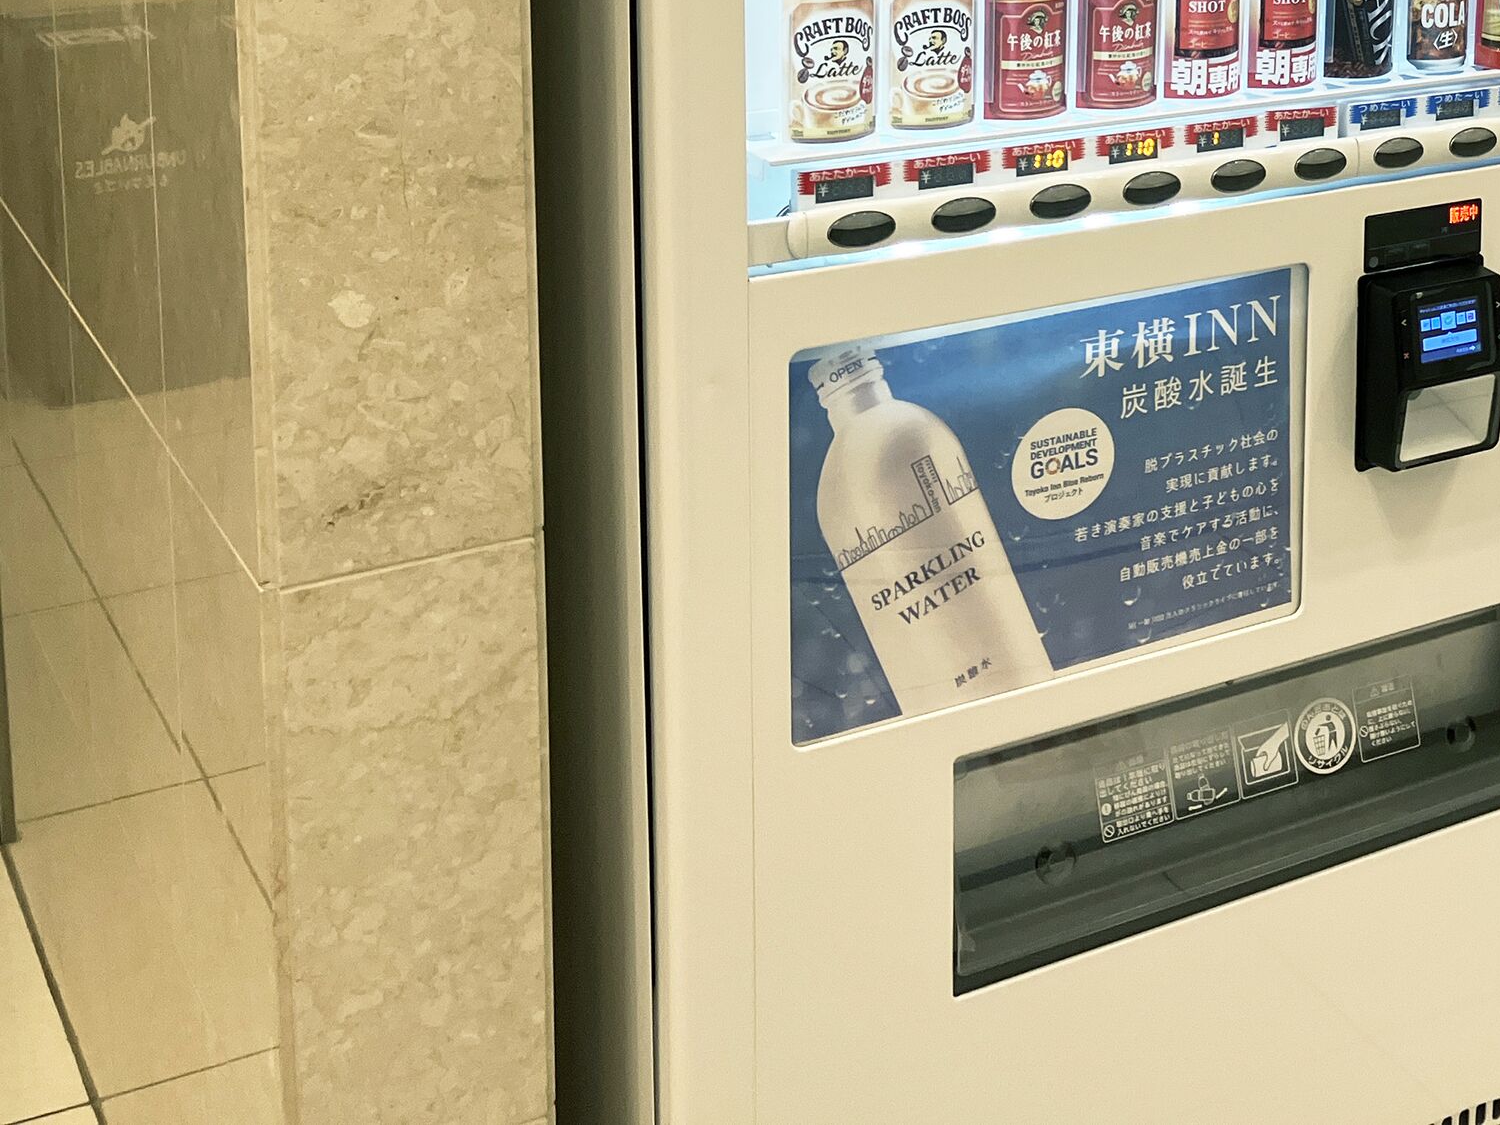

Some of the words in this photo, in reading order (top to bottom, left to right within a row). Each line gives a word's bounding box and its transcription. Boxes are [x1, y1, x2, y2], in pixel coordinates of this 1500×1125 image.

[1188, 0, 1226, 14] SHOT
[1421, 1, 1465, 29] COLA
[794, 17, 845, 57] CRAFT
[845, 16, 873, 52] BOSS
[894, 8, 942, 46] CRAFT
[943, 7, 972, 42] BOSS
[1006, 30, 1062, 52] 午後の紅茶
[1099, 21, 1153, 43] 午後の紅茶
[810, 61, 863, 79] Latte
[910, 51, 961, 67] Latte
[1448, 204, 1479, 225] 販売中
[1080, 295, 1281, 380] 東横INN
[828, 357, 864, 384] OPEN
[1119, 356, 1278, 419] 炭酸水誕生
[1030, 428, 1097, 450] SUSTAINABLE
[1030, 438, 1097, 461] DEVELOPMENT
[1144, 427, 1278, 473] 脱プラスチック社会の
[1031, 448, 1099, 480] GOALS
[1165, 454, 1279, 493] 実現に貢献します。
[1044, 487, 1084, 503] プロジェクト
[1074, 477, 1279, 545] 若き演奏家の支援と子どもの心を
[1139, 504, 1280, 552] 音楽でケアする活動に、
[870, 530, 987, 611] SPARKLING
[1118, 526, 1279, 583] 自動販売機売上金の一部を
[1181, 552, 1282, 590] 役立てています。
[897, 567, 982, 626] WATER
[1307, 746, 1349, 768] リサイクル
